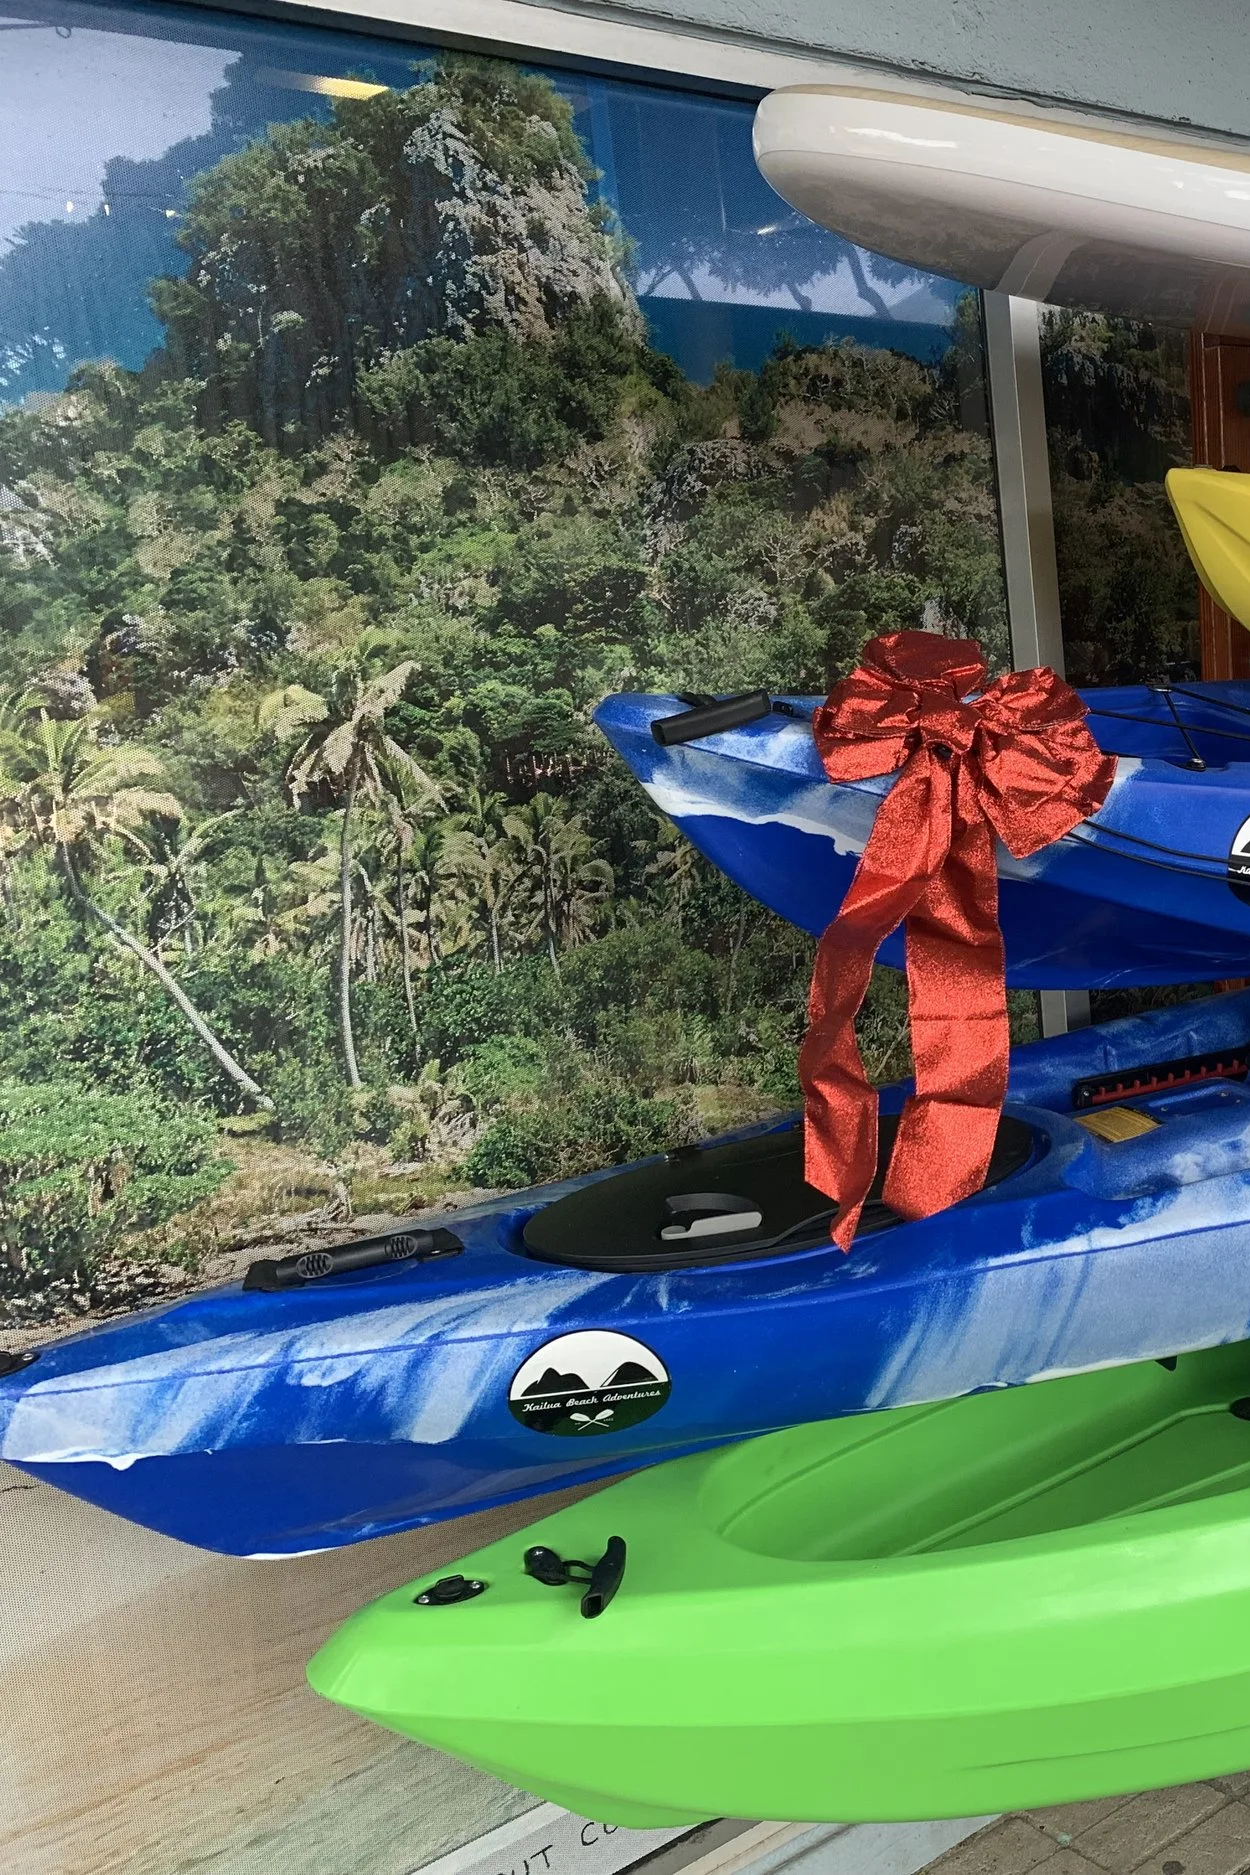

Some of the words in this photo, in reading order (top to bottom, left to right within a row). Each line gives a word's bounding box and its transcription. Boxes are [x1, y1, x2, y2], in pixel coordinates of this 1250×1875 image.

[522, 1402, 562, 1412] Kailua
[565, 1396, 599, 1407] Beach
[602, 1390, 661, 1402] Adventures
